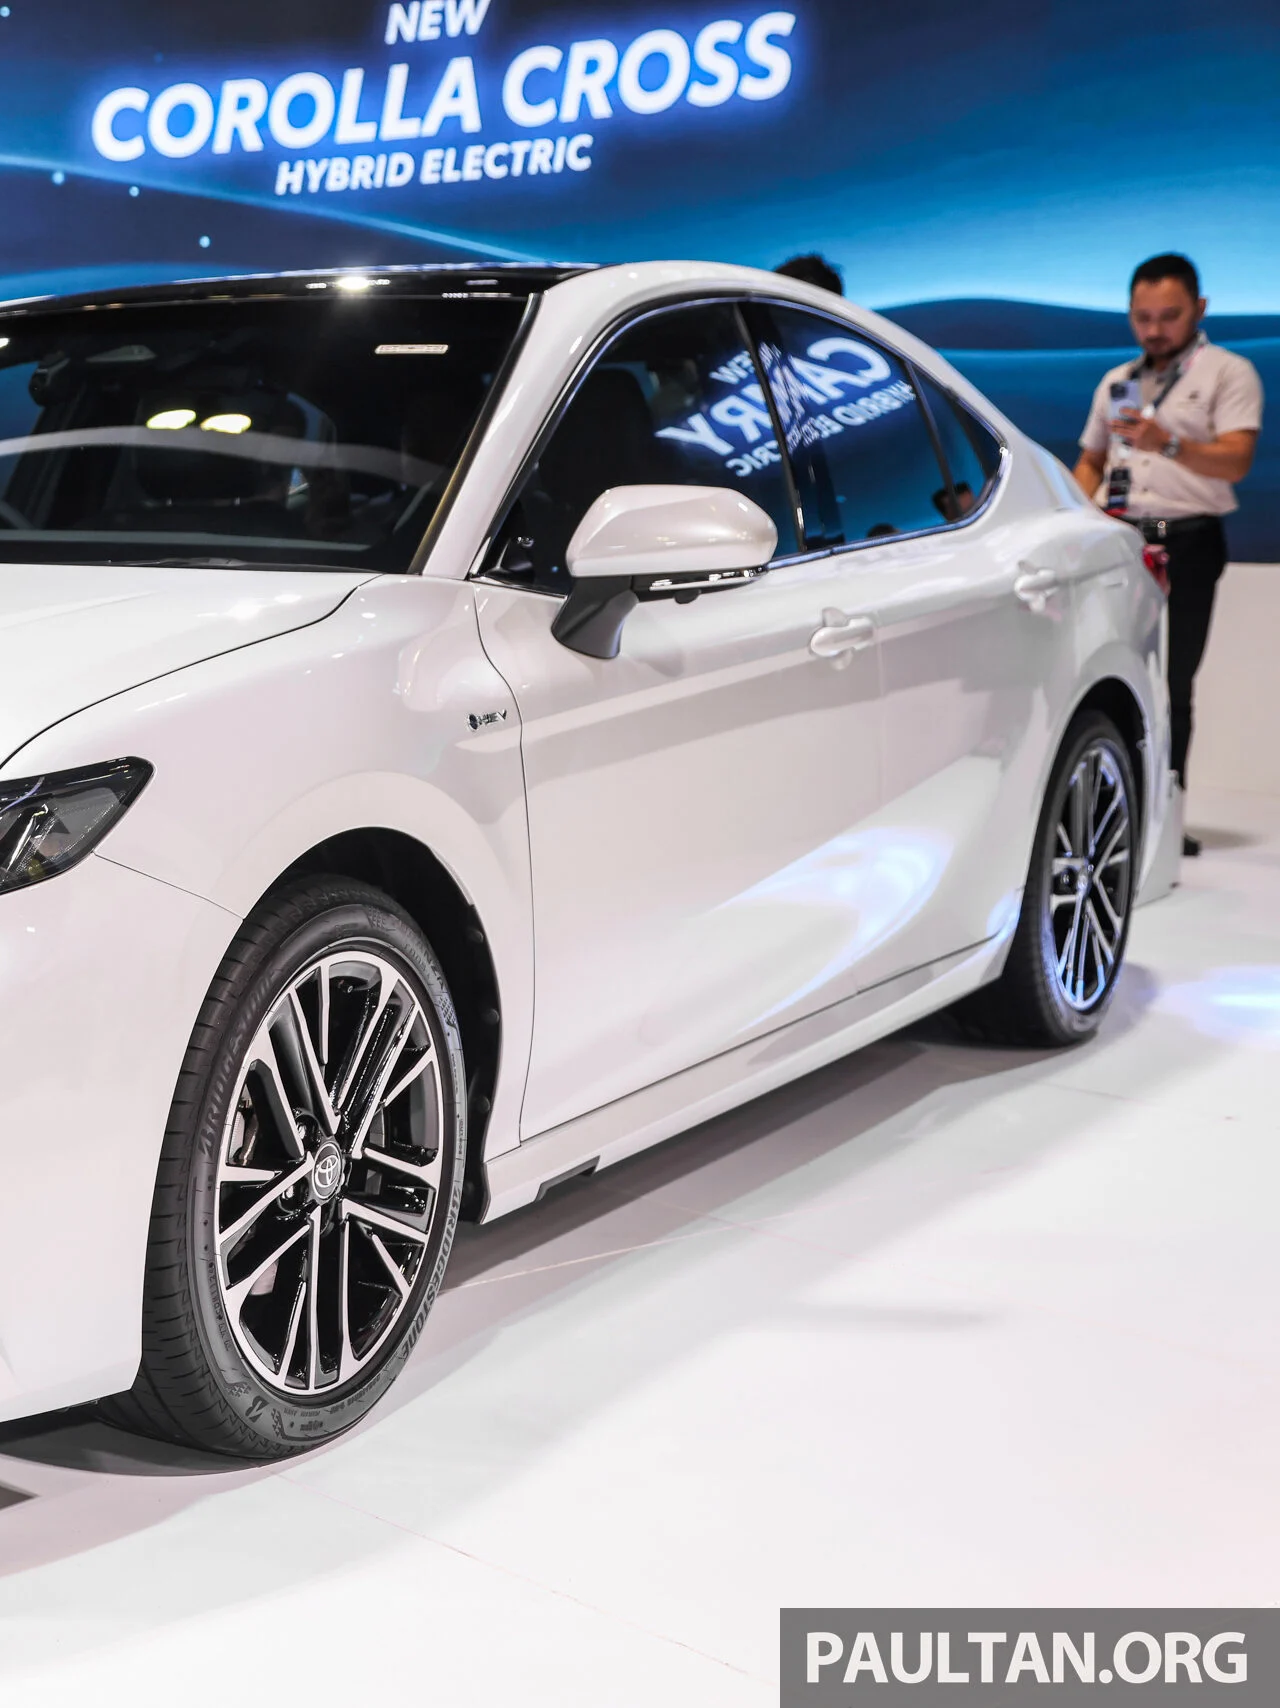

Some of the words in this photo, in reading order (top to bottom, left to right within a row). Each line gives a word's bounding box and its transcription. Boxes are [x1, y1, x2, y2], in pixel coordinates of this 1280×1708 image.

[385, 0, 491, 45] NEW
[91, 56, 482, 161] COROLLA
[502, 12, 796, 128] CROSS
[276, 151, 415, 196] HYBRID
[420, 135, 594, 185] ELECTRIC
[398, 1184, 462, 1362] BRIDGESTONE
